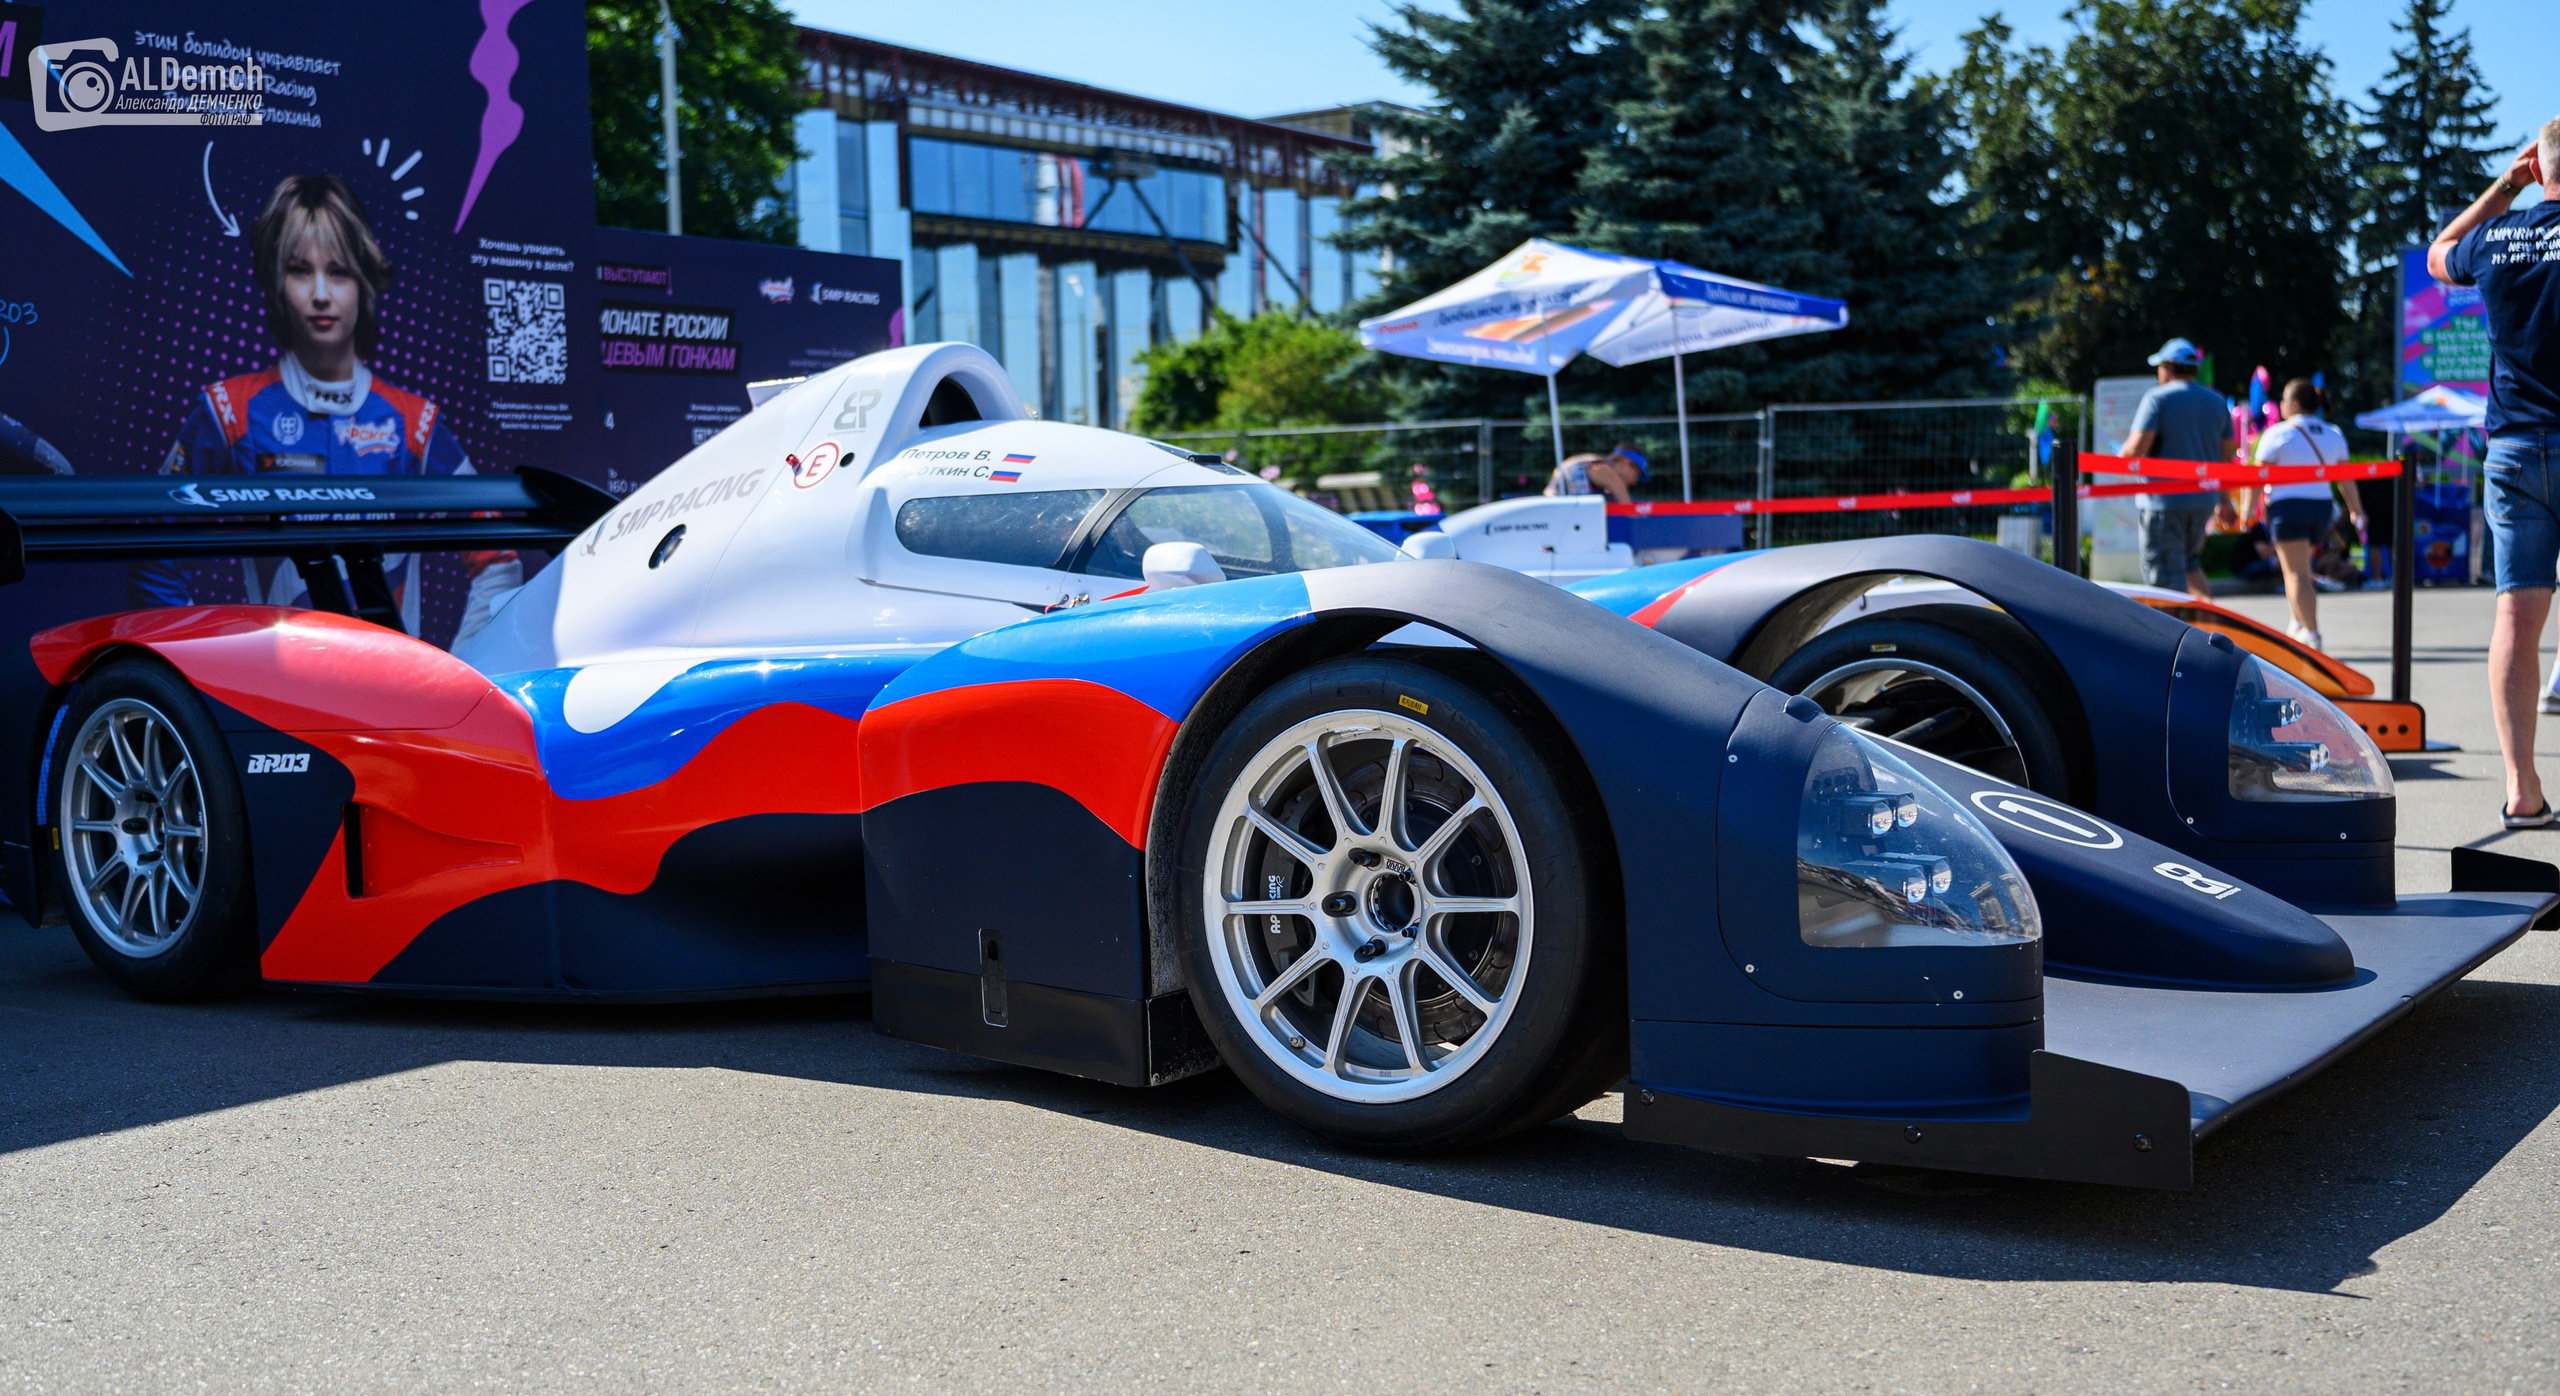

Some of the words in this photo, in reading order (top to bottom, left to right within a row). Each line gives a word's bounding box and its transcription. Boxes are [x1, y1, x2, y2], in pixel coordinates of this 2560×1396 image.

[255, 49, 342, 76] управляет
[262, 74, 317, 106] Racing
[663, 312, 729, 340] РОССИИ
[669, 344, 737, 370] ГОНКАМ
[805, 454, 827, 478] E
[901, 449, 970, 462] Петров
[974, 450, 991, 461] В.
[973, 465, 989, 478] С.
[210, 489, 271, 501] SMP
[274, 488, 376, 501] RACING
[608, 503, 663, 541] SMP
[660, 469, 766, 521] RACING
[1268, 875, 1277, 899] CING
